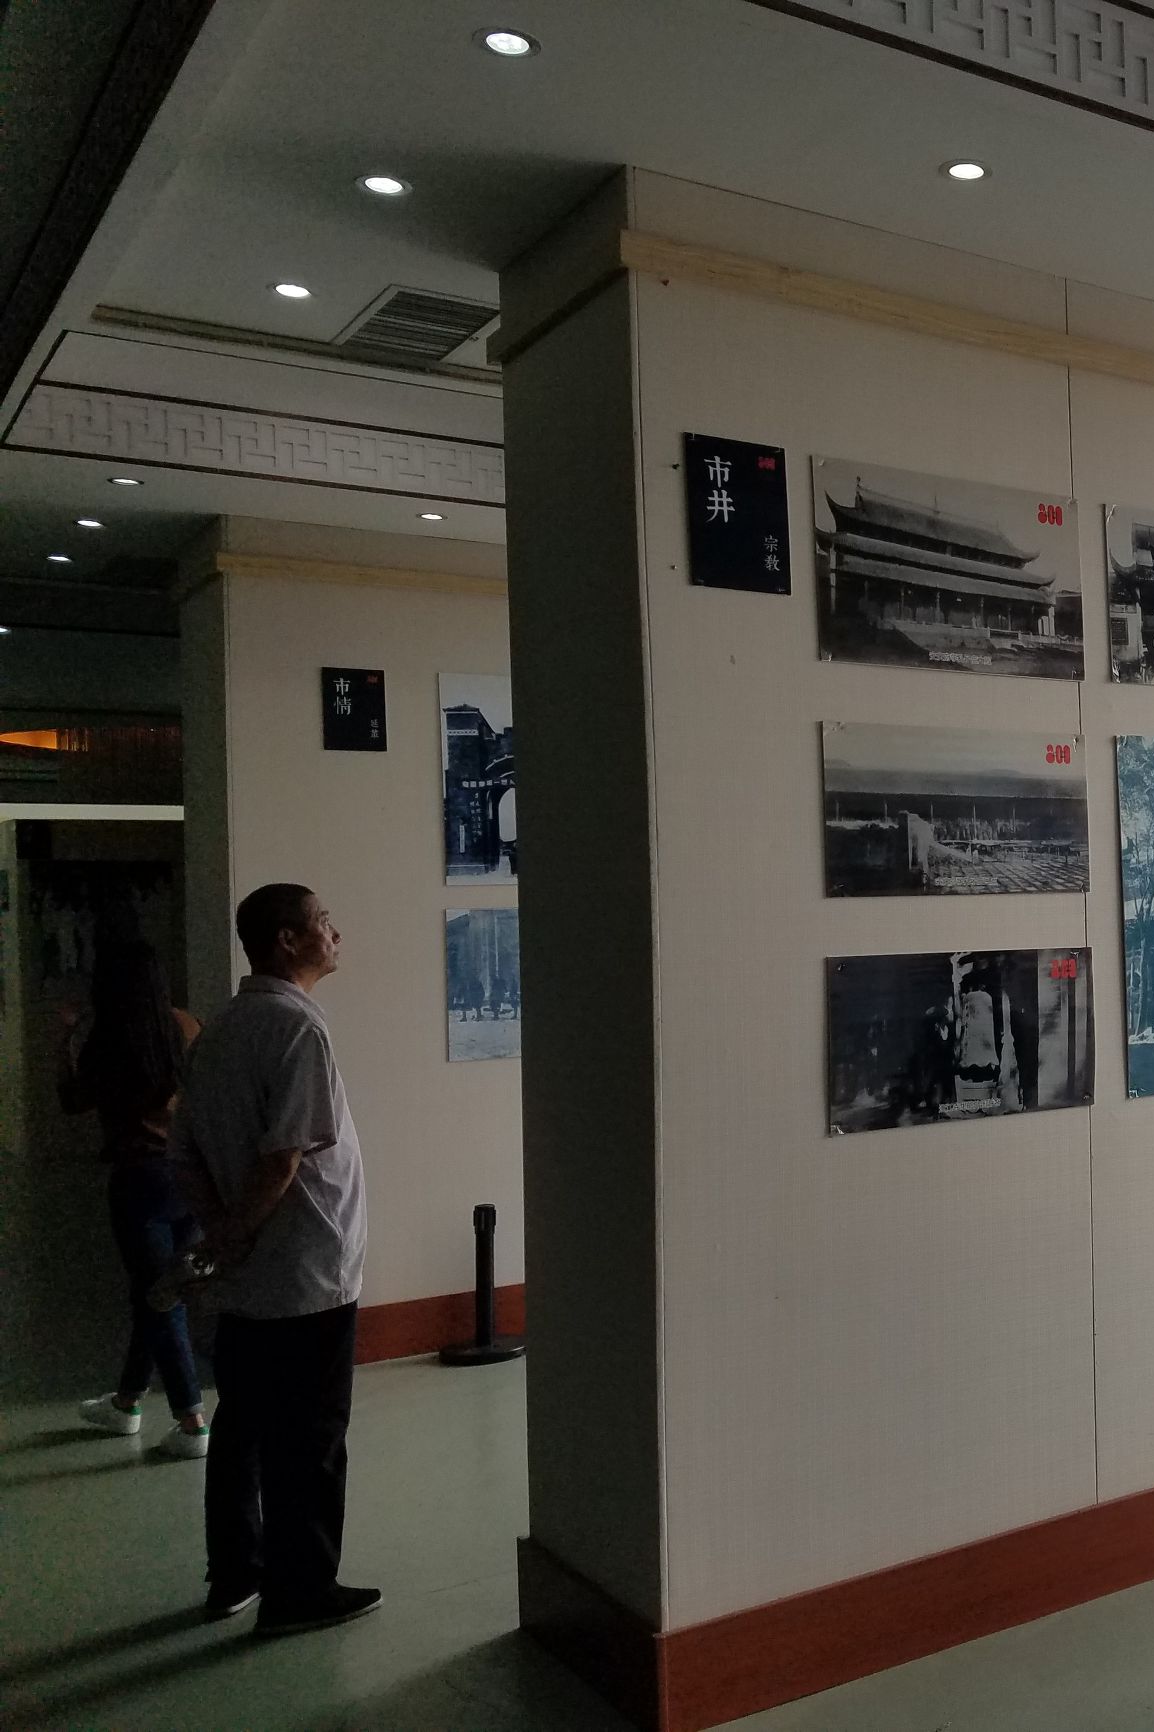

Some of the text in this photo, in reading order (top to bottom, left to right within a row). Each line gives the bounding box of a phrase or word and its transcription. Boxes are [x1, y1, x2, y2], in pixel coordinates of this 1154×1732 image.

[703, 455, 736, 524] 市井
[764, 534, 781, 572] 宗教
[333, 677, 352, 716] 市情
